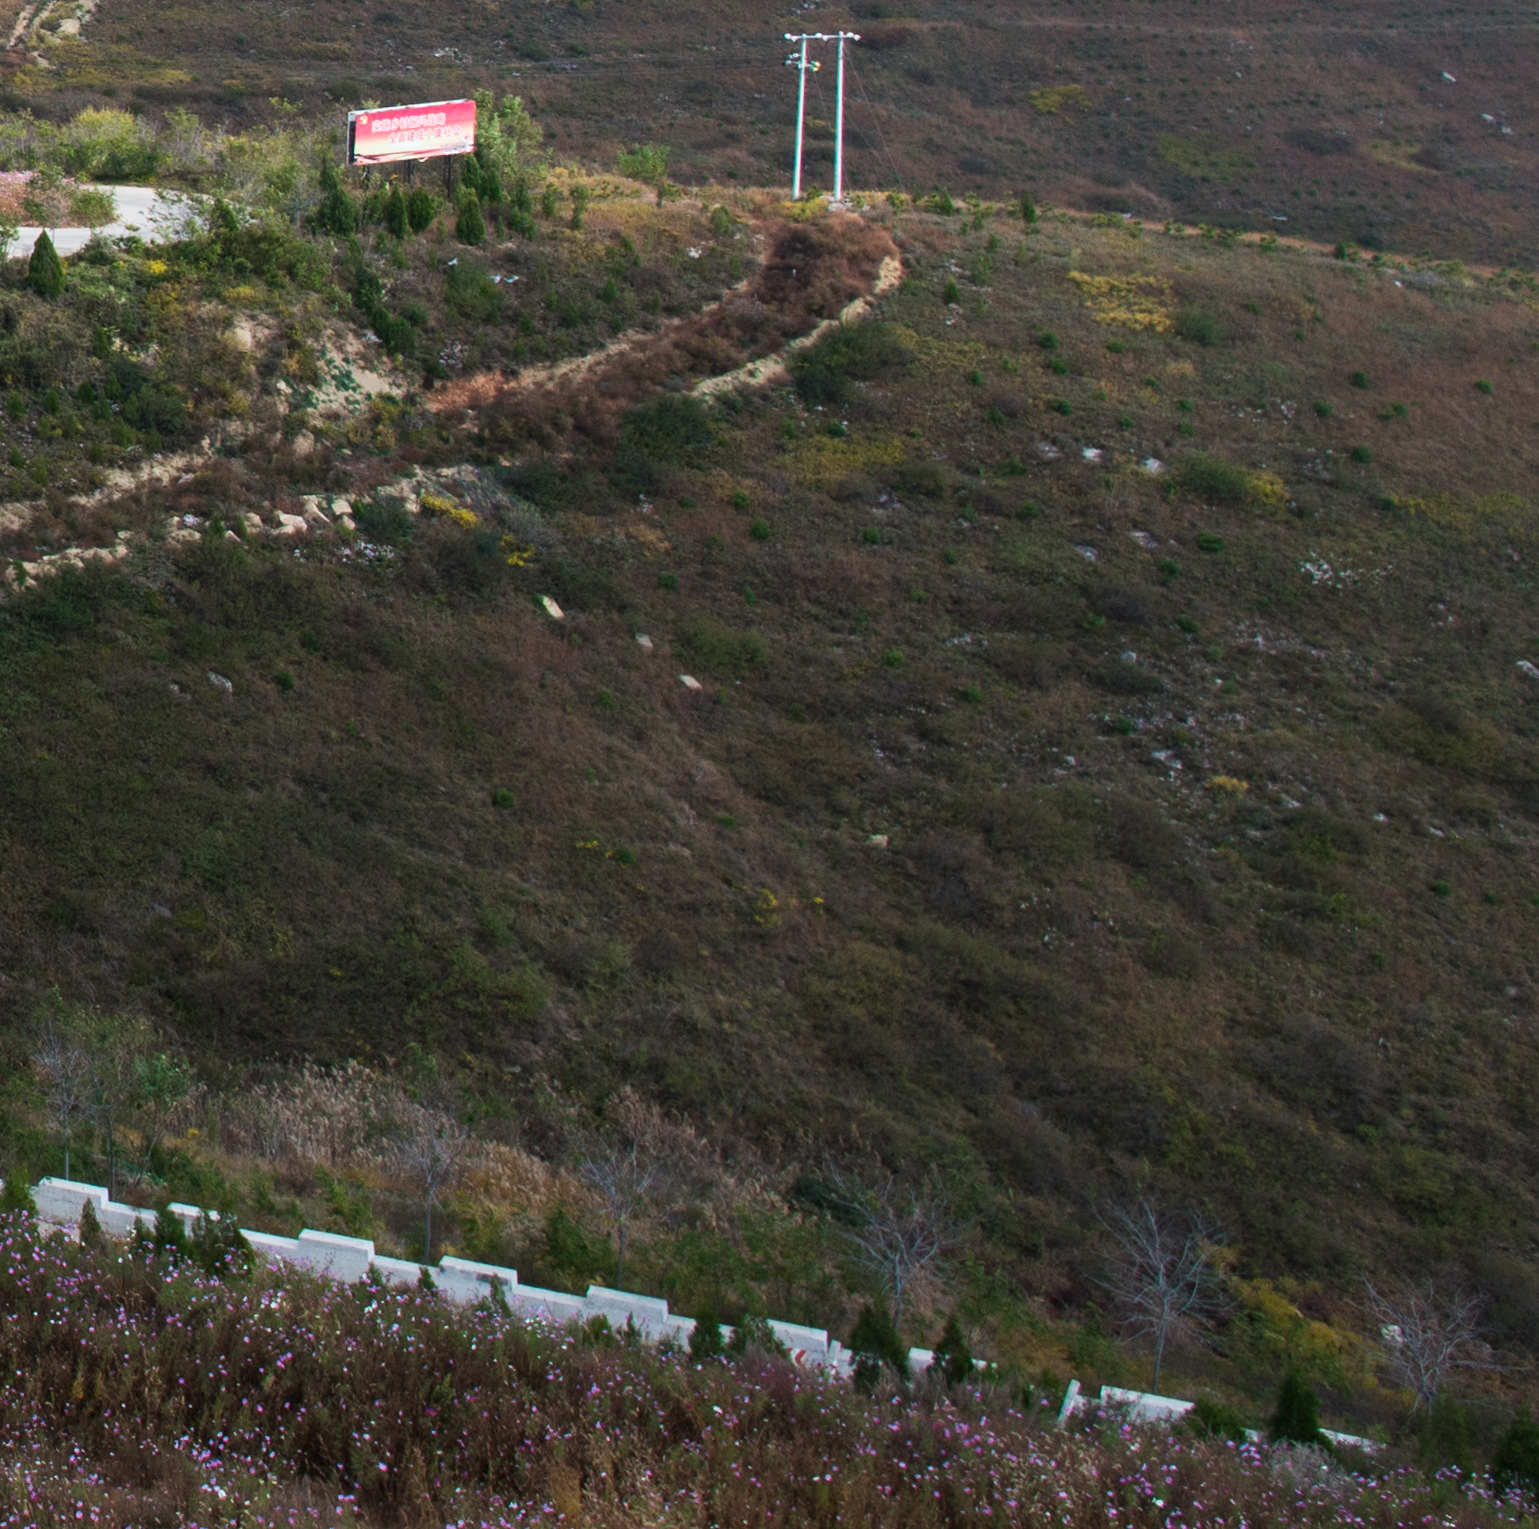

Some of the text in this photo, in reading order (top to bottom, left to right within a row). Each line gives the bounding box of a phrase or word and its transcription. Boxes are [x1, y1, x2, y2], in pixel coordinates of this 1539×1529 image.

[388, 125, 462, 144] 全面建成小康社会
